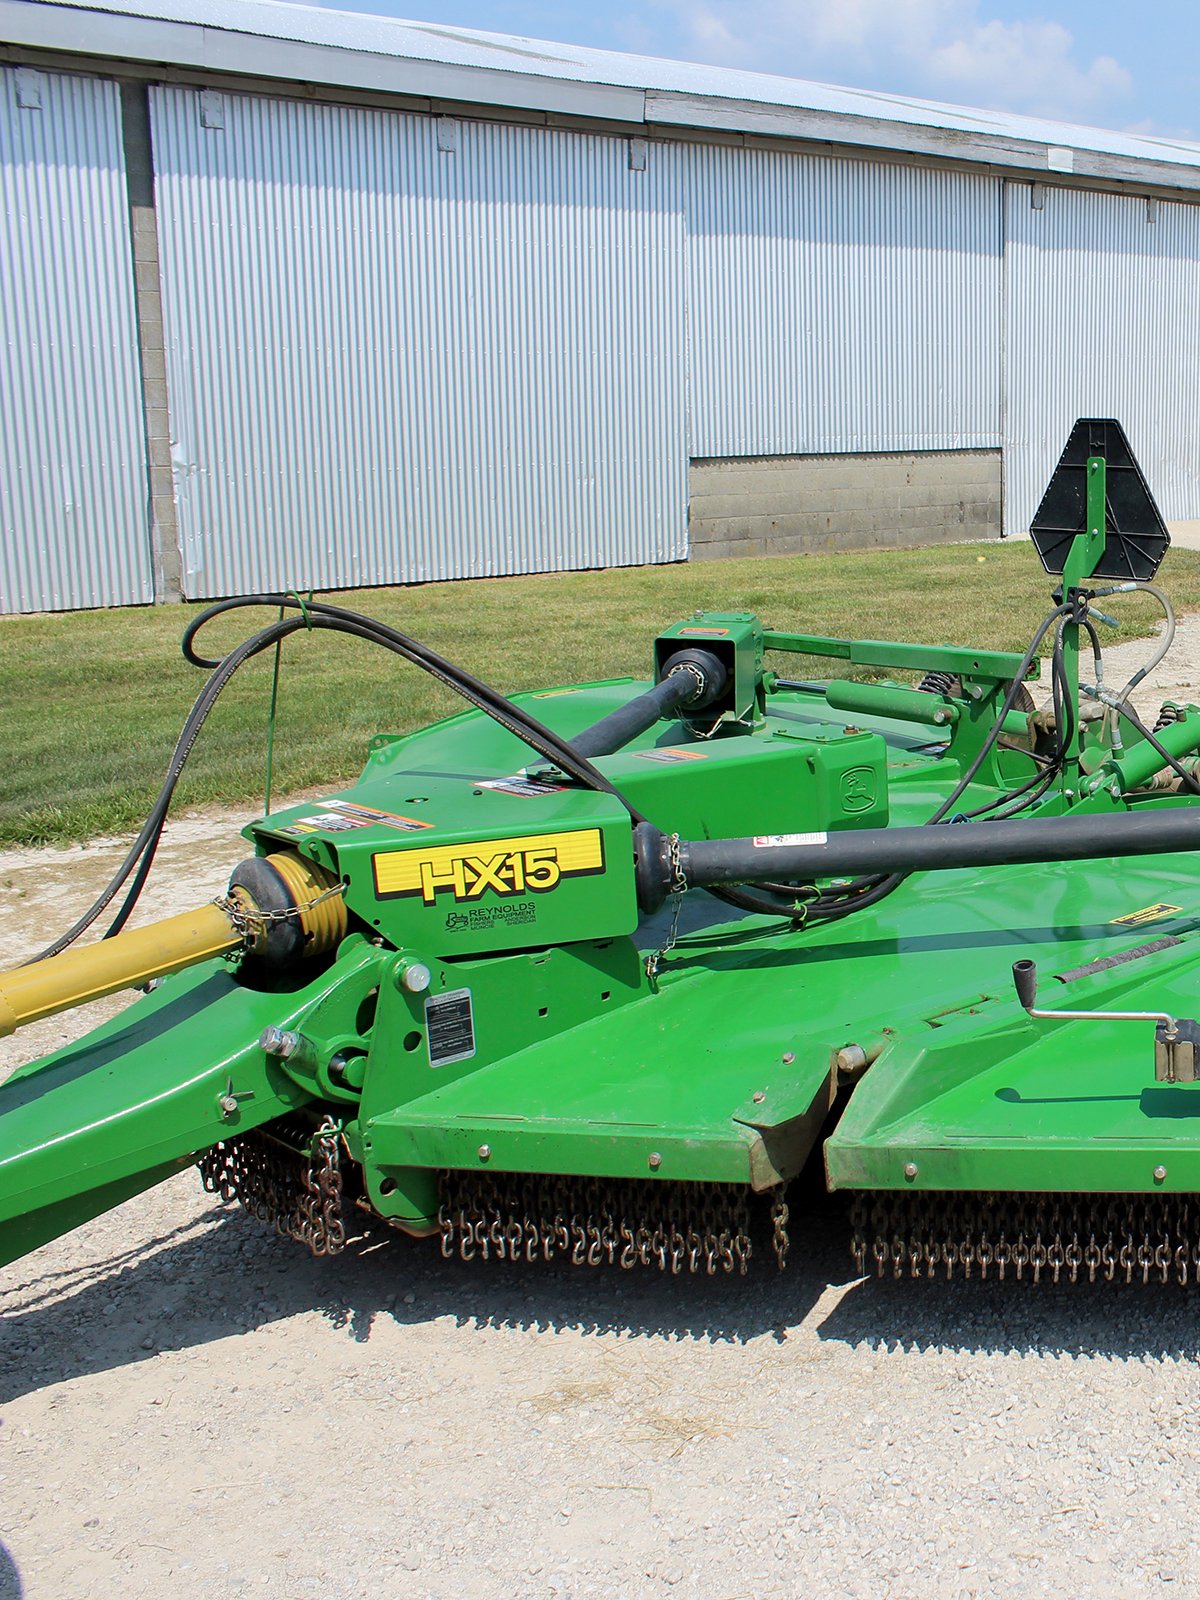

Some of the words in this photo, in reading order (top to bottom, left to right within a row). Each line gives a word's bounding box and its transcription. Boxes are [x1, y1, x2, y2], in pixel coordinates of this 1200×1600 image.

[469, 902, 536, 918] REYNOLDS
[469, 915, 490, 923] FARM
[492, 910, 536, 921] EQUIPMENT
